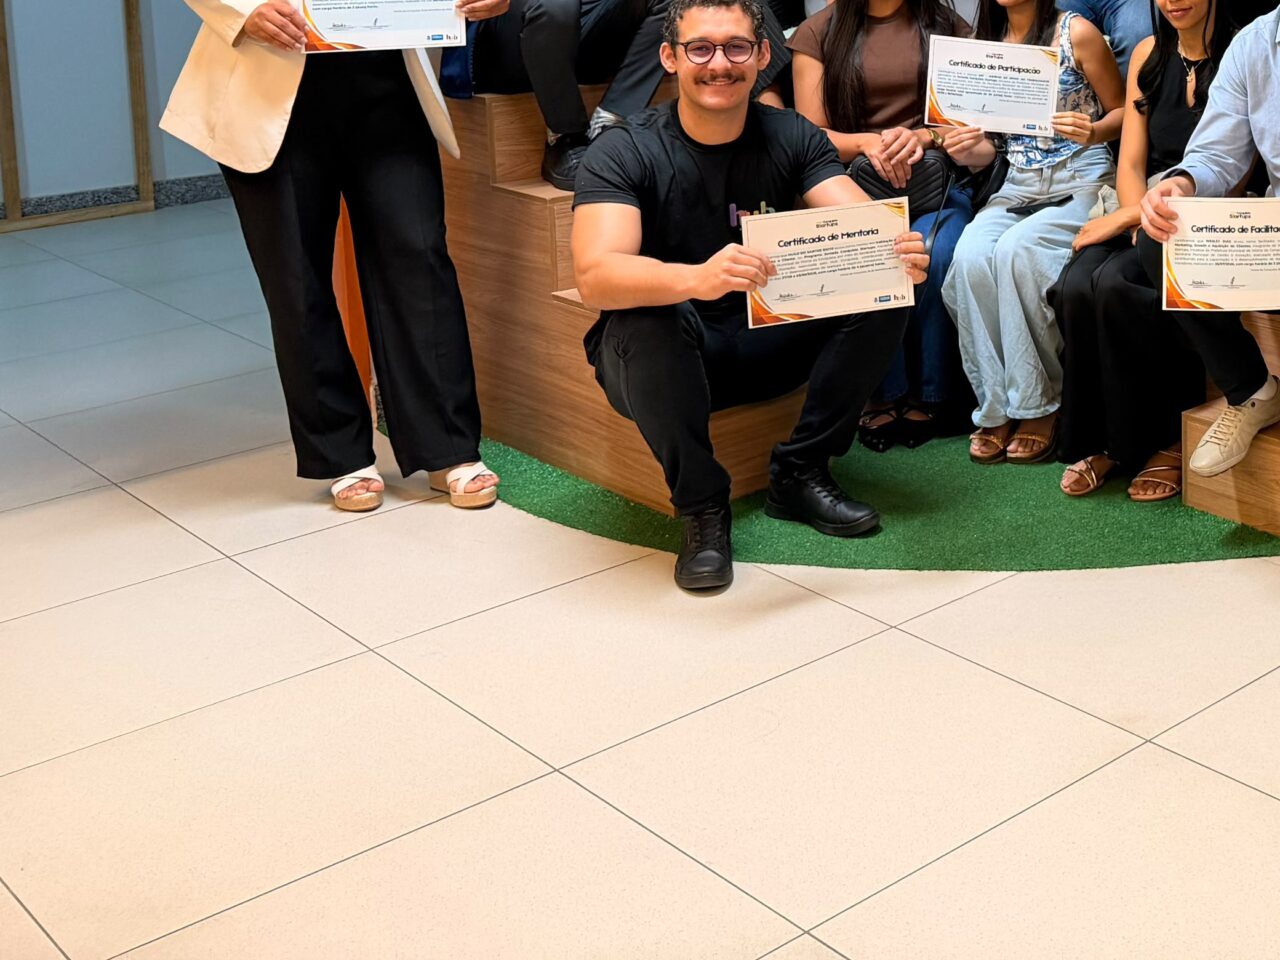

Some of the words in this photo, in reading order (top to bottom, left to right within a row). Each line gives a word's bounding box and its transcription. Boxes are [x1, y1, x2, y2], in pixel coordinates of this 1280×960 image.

[948, 59, 986, 70] Certificado
[987, 63, 997, 71] de
[1190, 224, 1237, 234] Certificado
[1237, 224, 1249, 234] de
[777, 234, 826, 248] Certificado
[827, 232, 839, 241] de
[840, 227, 880, 240] Mentoria
